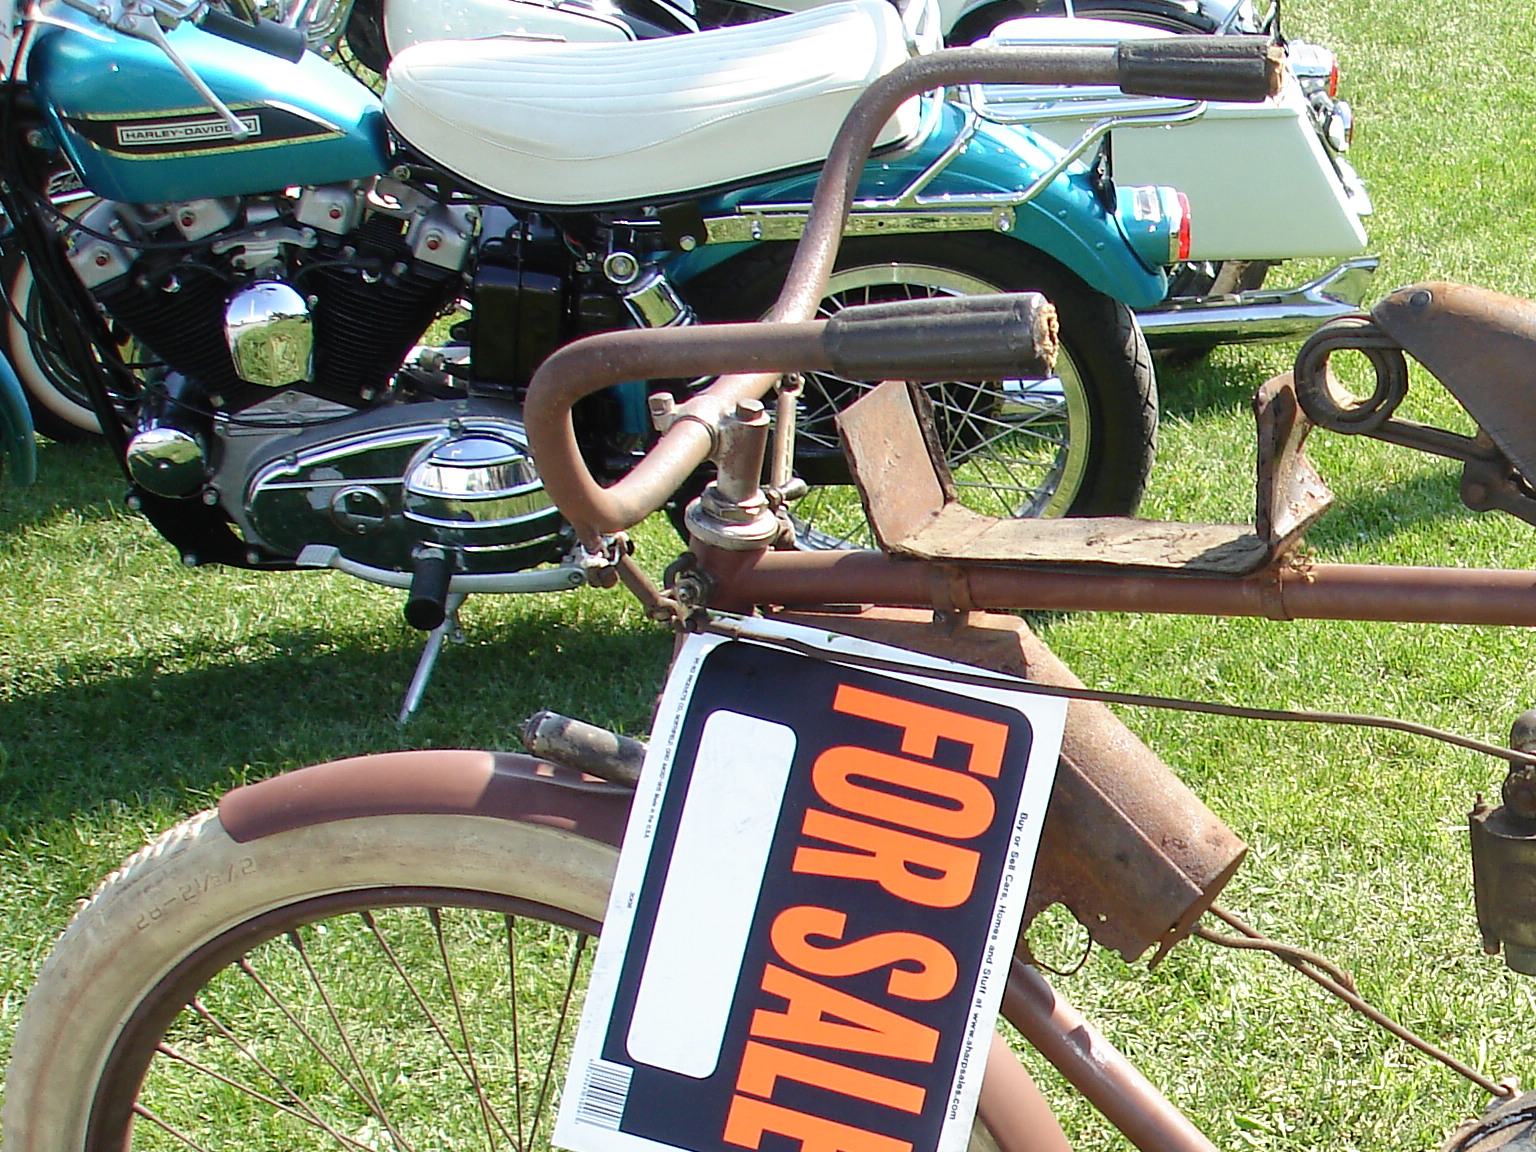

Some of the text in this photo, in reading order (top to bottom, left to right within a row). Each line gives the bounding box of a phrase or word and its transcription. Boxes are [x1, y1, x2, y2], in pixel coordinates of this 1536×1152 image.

[126, 121, 253, 139] HARLEY-DAVIDN
[792, 683, 1007, 908] FOR
[948, 812, 1028, 1120] Buy or Sell Cars, Homes and Stuff at www.sharpsales.com
